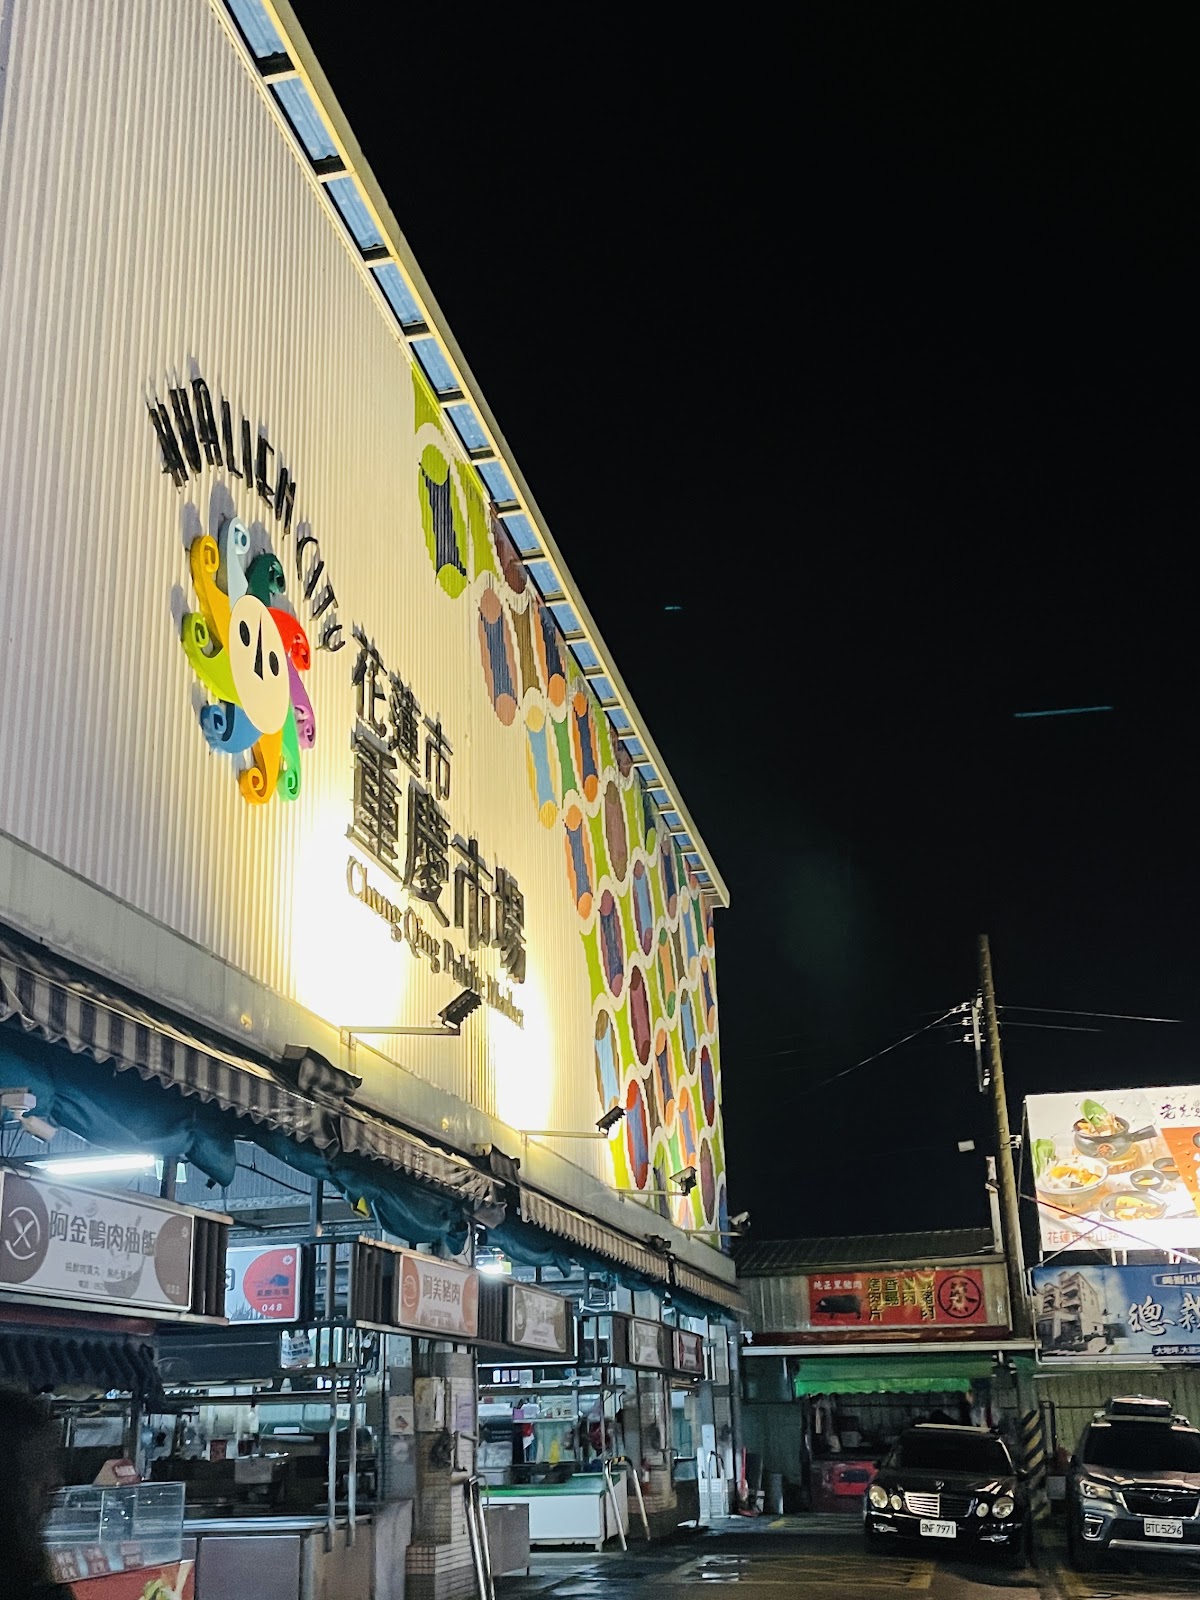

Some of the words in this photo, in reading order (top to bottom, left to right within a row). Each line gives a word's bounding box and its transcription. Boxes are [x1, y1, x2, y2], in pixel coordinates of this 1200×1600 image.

[350, 628, 454, 800] 花蓮市
[345, 732, 527, 985] 重慶市場
[261, 1303, 283, 1313] 048
